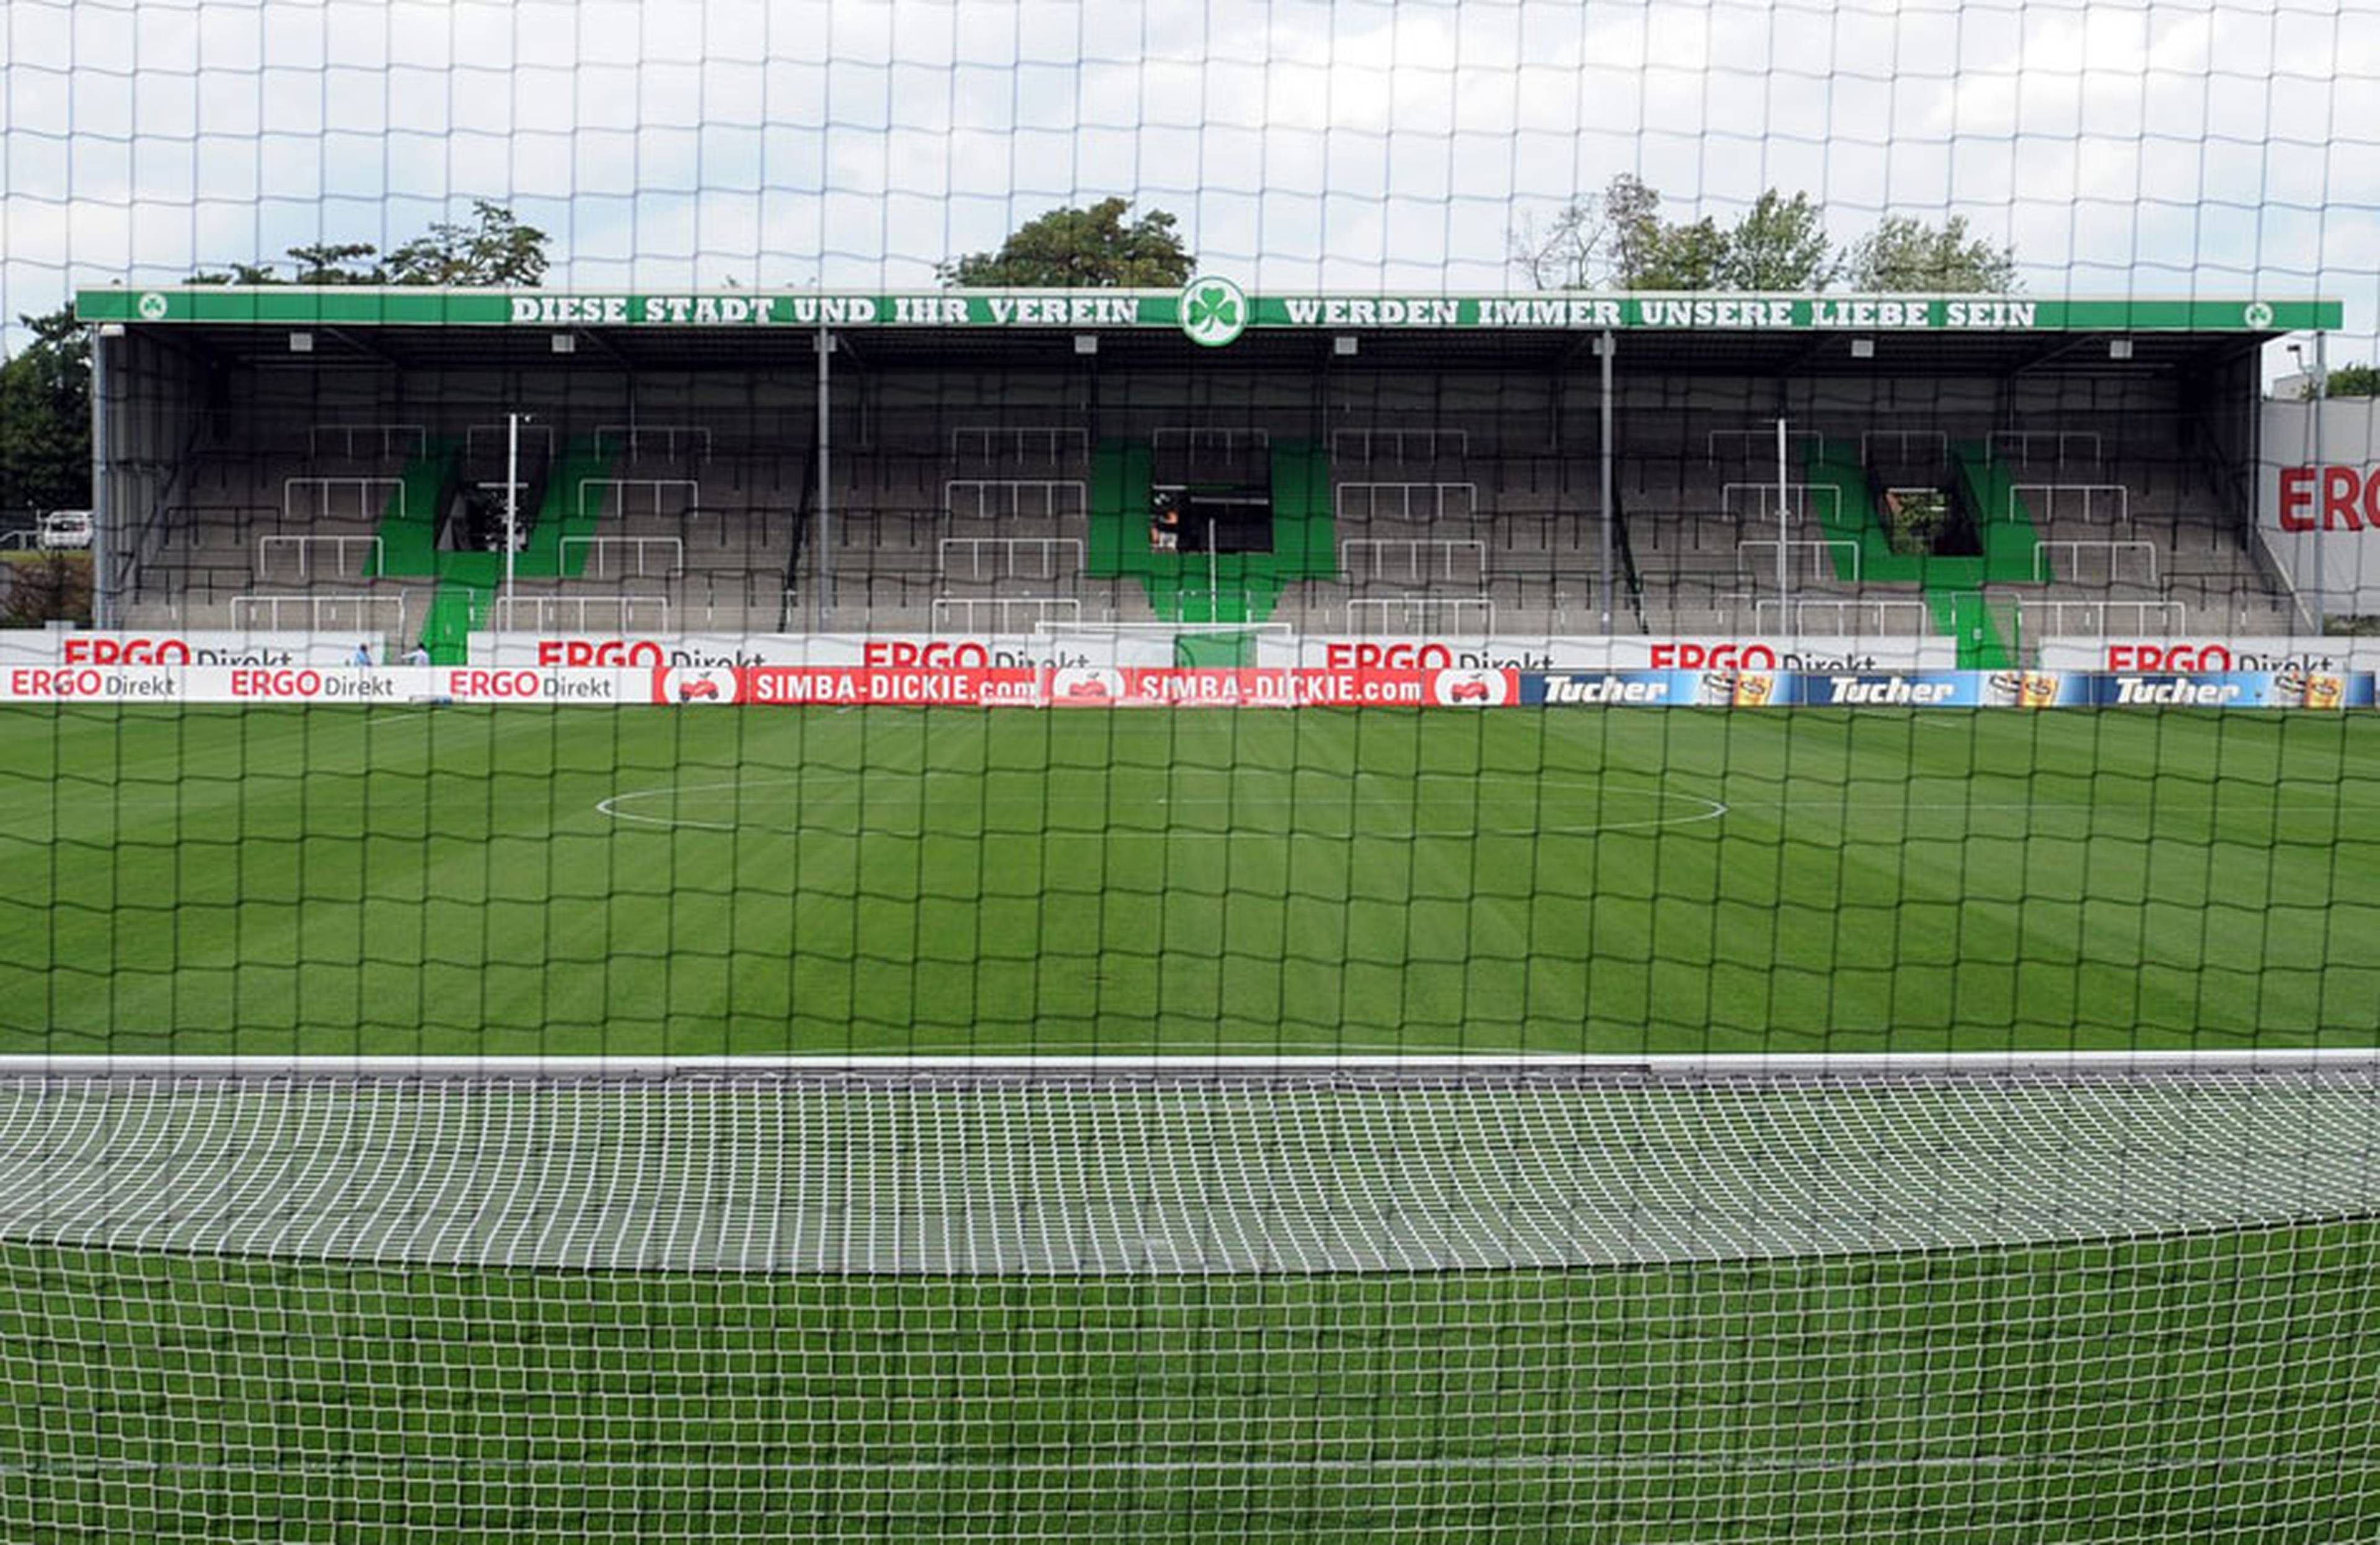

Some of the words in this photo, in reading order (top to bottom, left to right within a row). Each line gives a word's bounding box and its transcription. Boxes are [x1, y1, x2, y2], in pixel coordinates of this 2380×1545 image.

[511, 297, 626, 322] DIESE
[645, 297, 774, 323] STADT
[794, 298, 876, 323] UND
[894, 299, 969, 323] IHR
[988, 299, 1139, 324] VEREIN
[1284, 300, 1459, 324] WERDEN
[1478, 301, 1620, 325] IMMER
[1640, 301, 1793, 326] UNSERE
[1811, 301, 1929, 327] LIEBE
[1946, 302, 2037, 327] SEIN
[64, 639, 191, 666] ERGO
[538, 641, 664, 667] ERGO
[863, 642, 989, 667] ERGO
[1326, 643, 1452, 669] ERGO
[1650, 645, 1775, 669] ERGO
[2109, 645, 2231, 671] ERGO
[12, 669, 102, 695] ERGO
[106, 676, 175, 696] Direkt
[231, 670, 320, 696] ERGO
[324, 676, 394, 697] Direkt
[450, 671, 540, 697] ERGO
[544, 677, 612, 698] Direkt
[757, 674, 1035, 699] SIMBA-DICKIE.com
[1142, 675, 1421, 701] SIMBA-DICKIE.com
[1545, 676, 1668, 703] Tucher
[1830, 677, 1955, 703] Tucher
[2116, 678, 2241, 704] Tucher
